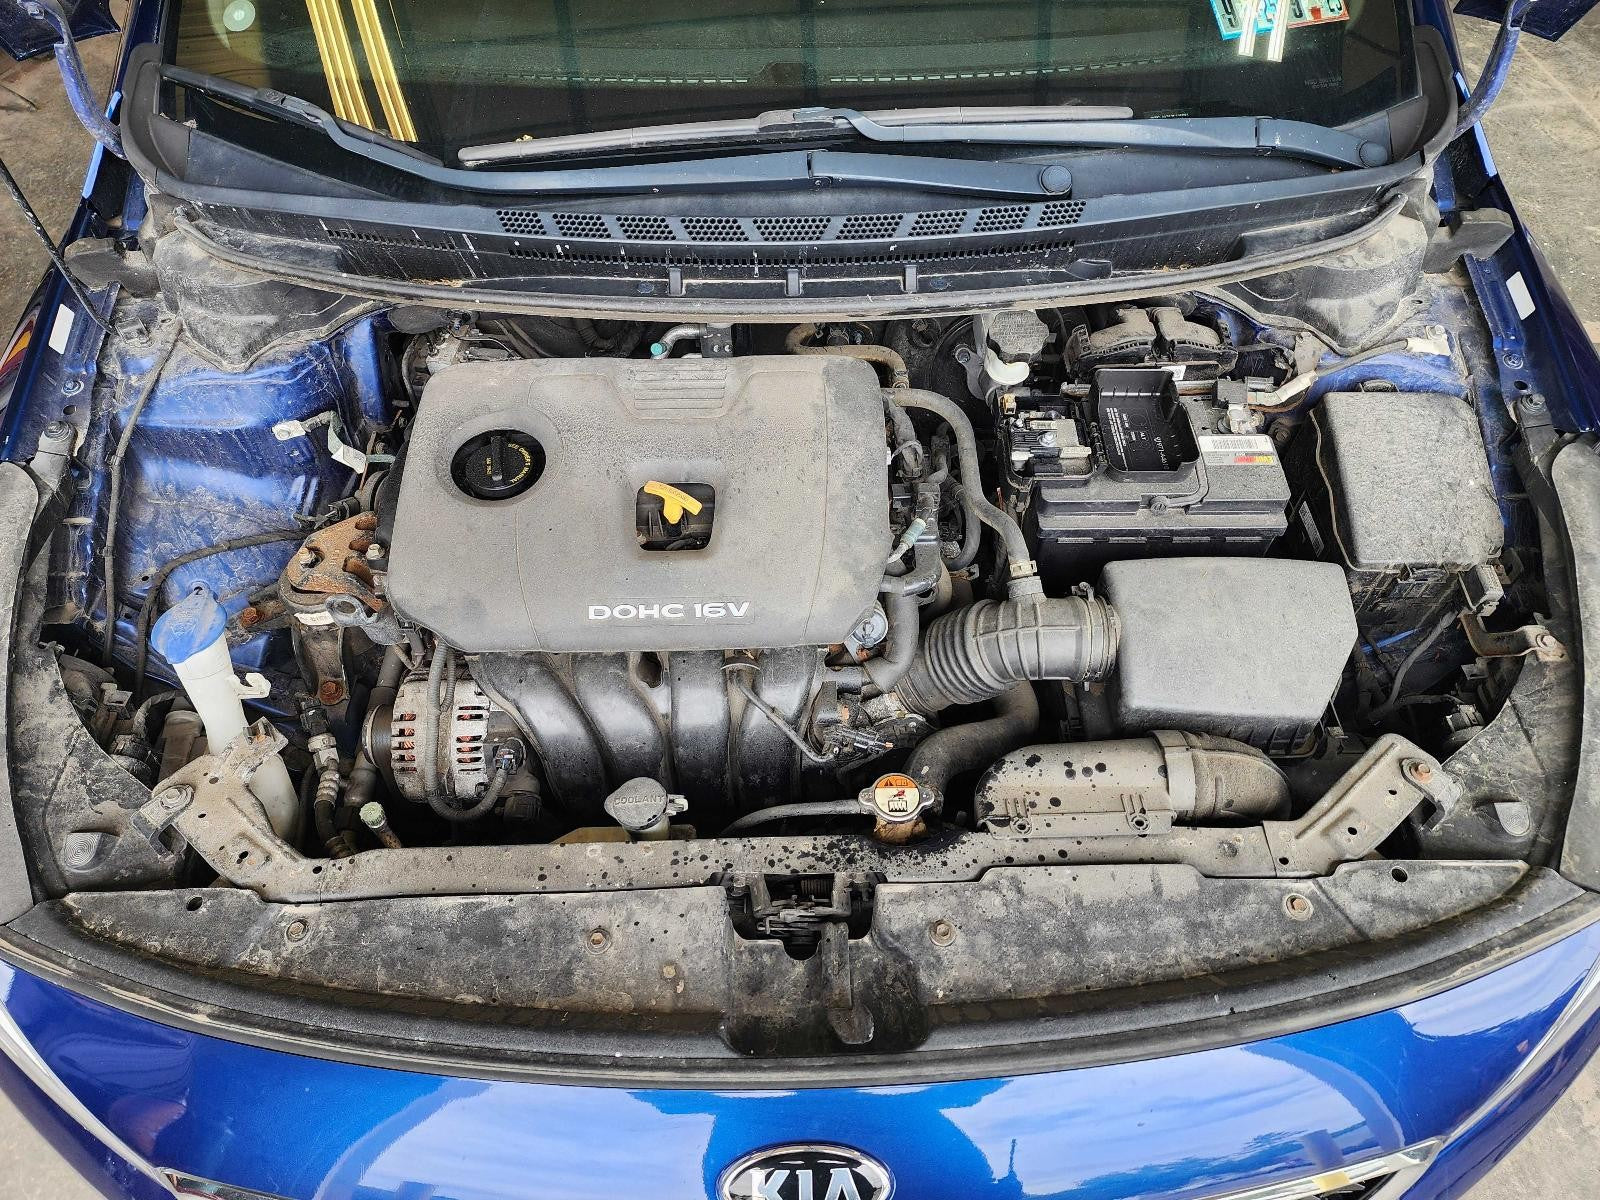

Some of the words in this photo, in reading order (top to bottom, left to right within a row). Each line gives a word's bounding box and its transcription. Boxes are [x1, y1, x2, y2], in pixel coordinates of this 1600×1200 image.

[588, 603, 685, 620] DOHC
[693, 602, 751, 618] 16V
[613, 794, 665, 806] COOLANT
[751, 1167, 862, 1200] KIA
